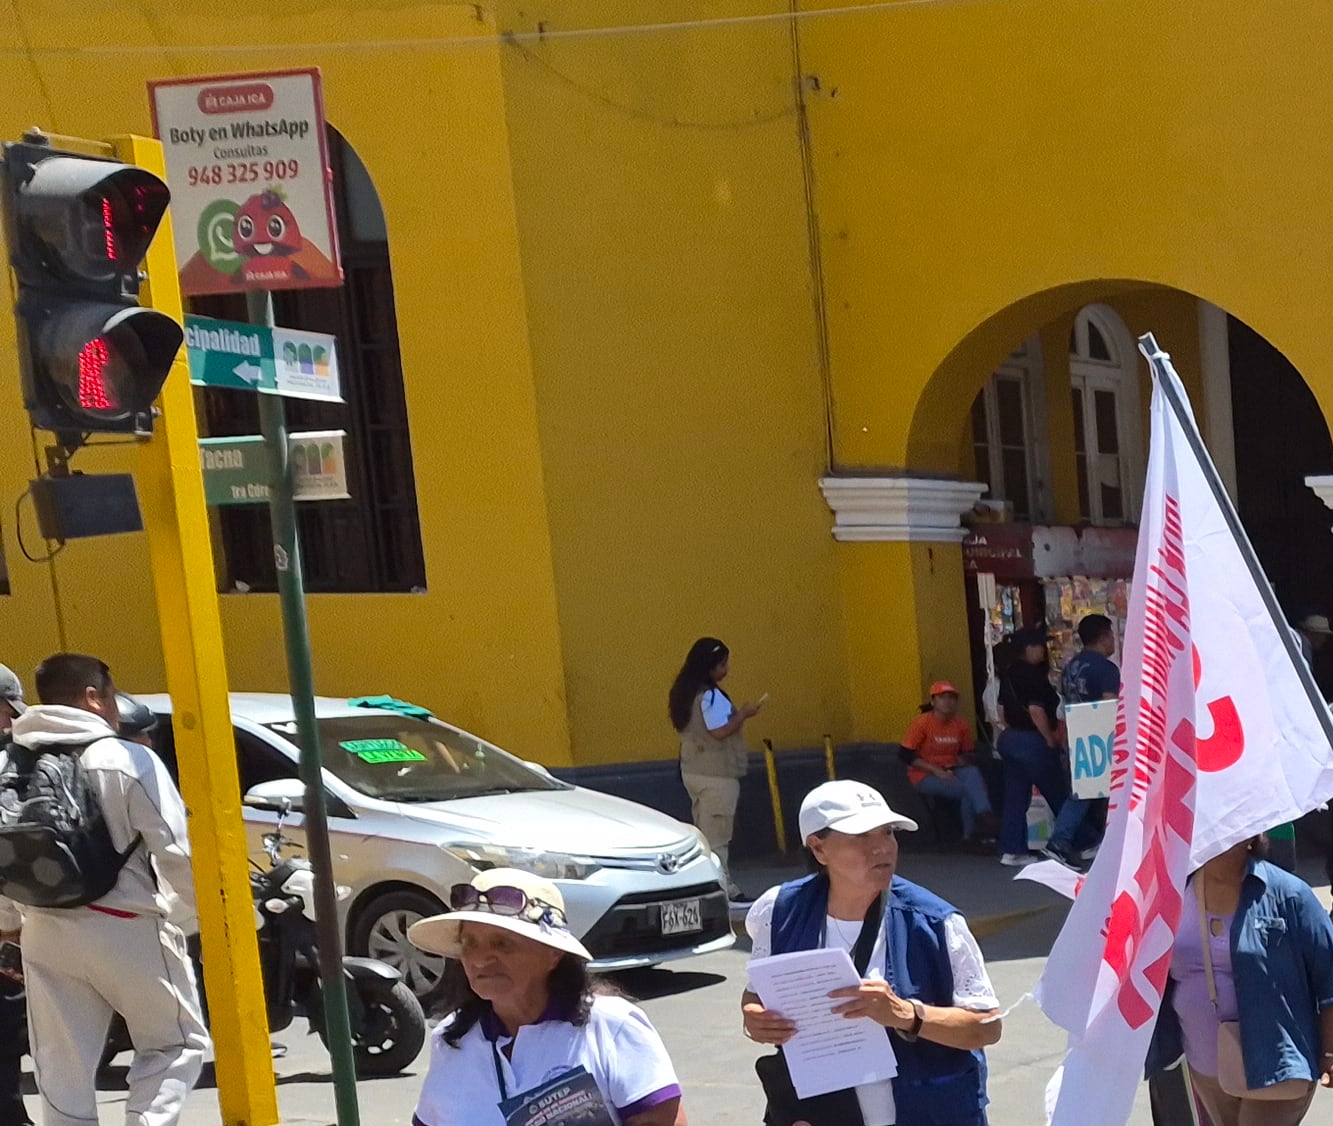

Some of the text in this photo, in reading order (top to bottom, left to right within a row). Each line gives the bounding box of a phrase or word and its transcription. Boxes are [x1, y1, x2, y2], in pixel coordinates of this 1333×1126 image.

[219, 92, 265, 107] CAJA ICA
[170, 118, 309, 146] Boty en WhatsApp
[213, 144, 269, 160] Consultas
[188, 159, 299, 186] 948 325 909
[538, 1086, 571, 1109] SUTEP
